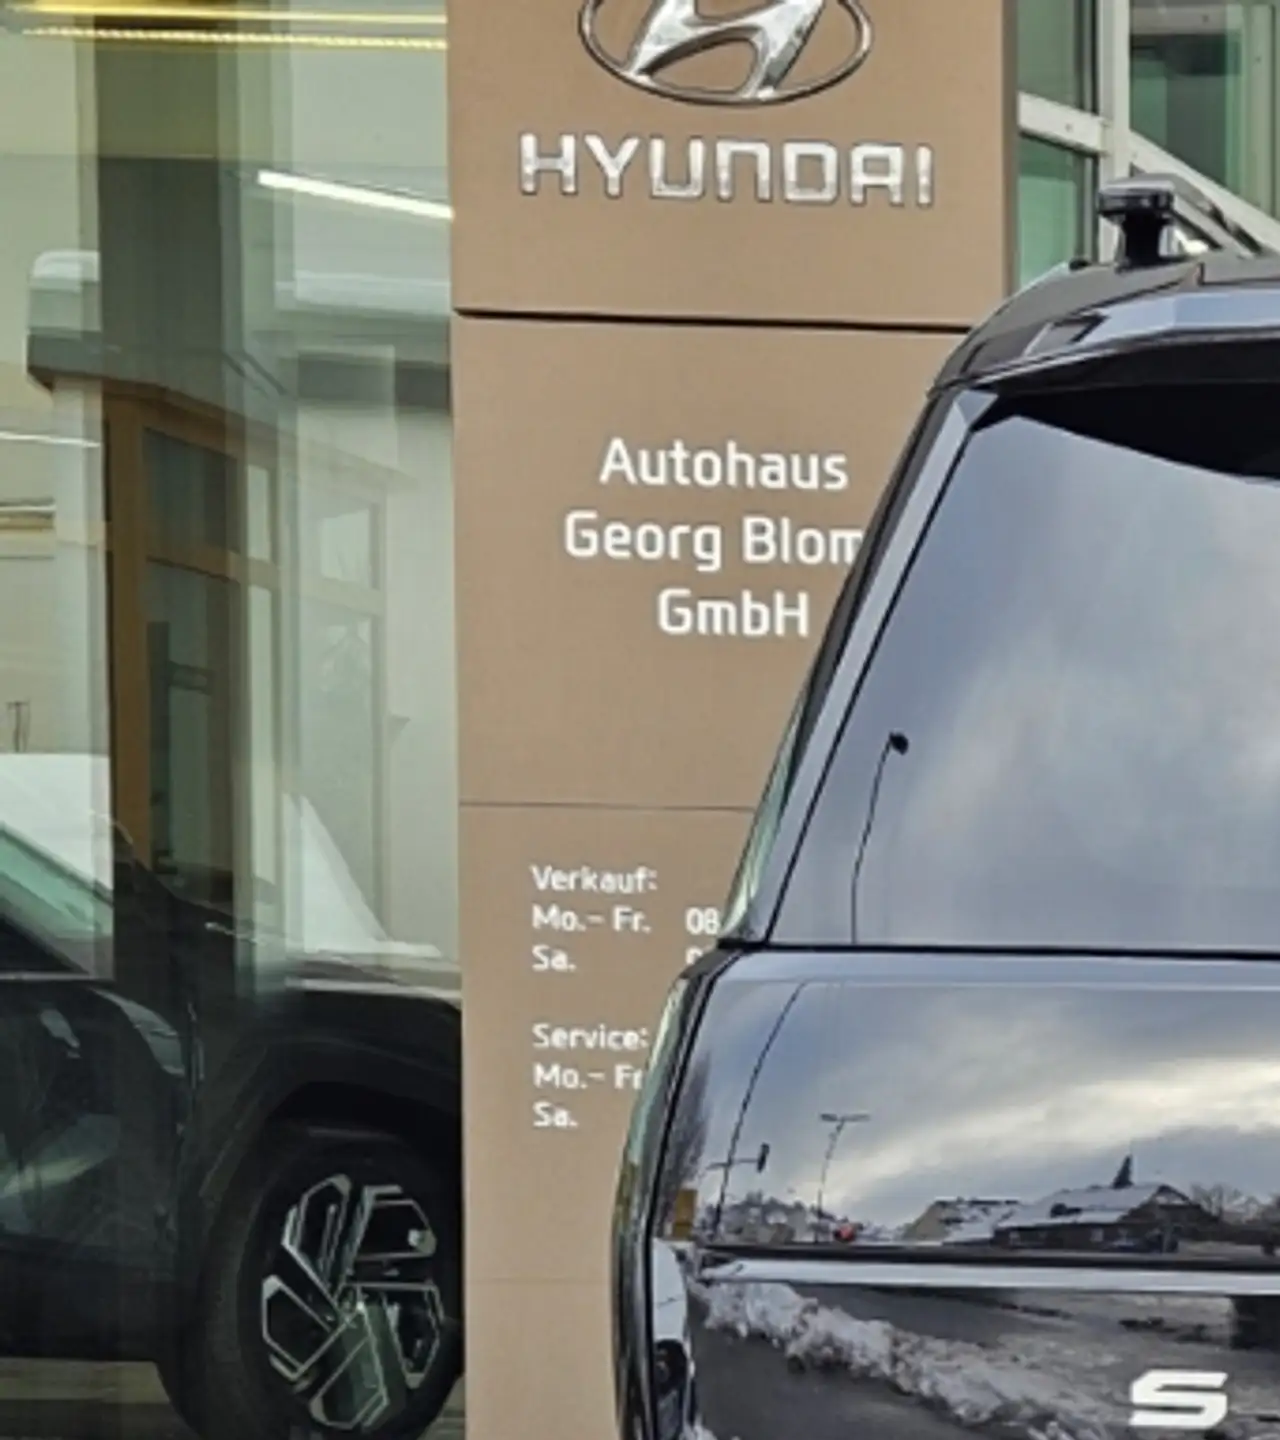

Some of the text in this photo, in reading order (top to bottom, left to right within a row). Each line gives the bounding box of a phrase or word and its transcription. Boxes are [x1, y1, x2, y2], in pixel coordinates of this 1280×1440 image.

[519, 132, 933, 206] HYUNDAI
[599, 437, 849, 491] Autohaus
[564, 510, 722, 572] Georg
[657, 587, 810, 638] GmbH
[530, 865, 658, 894] Verkauf:
[612, 907, 651, 933] Fr.
[531, 944, 577, 971] Sa.
[532, 1023, 649, 1050] Service:
[532, 1101, 577, 1128] Sa.
